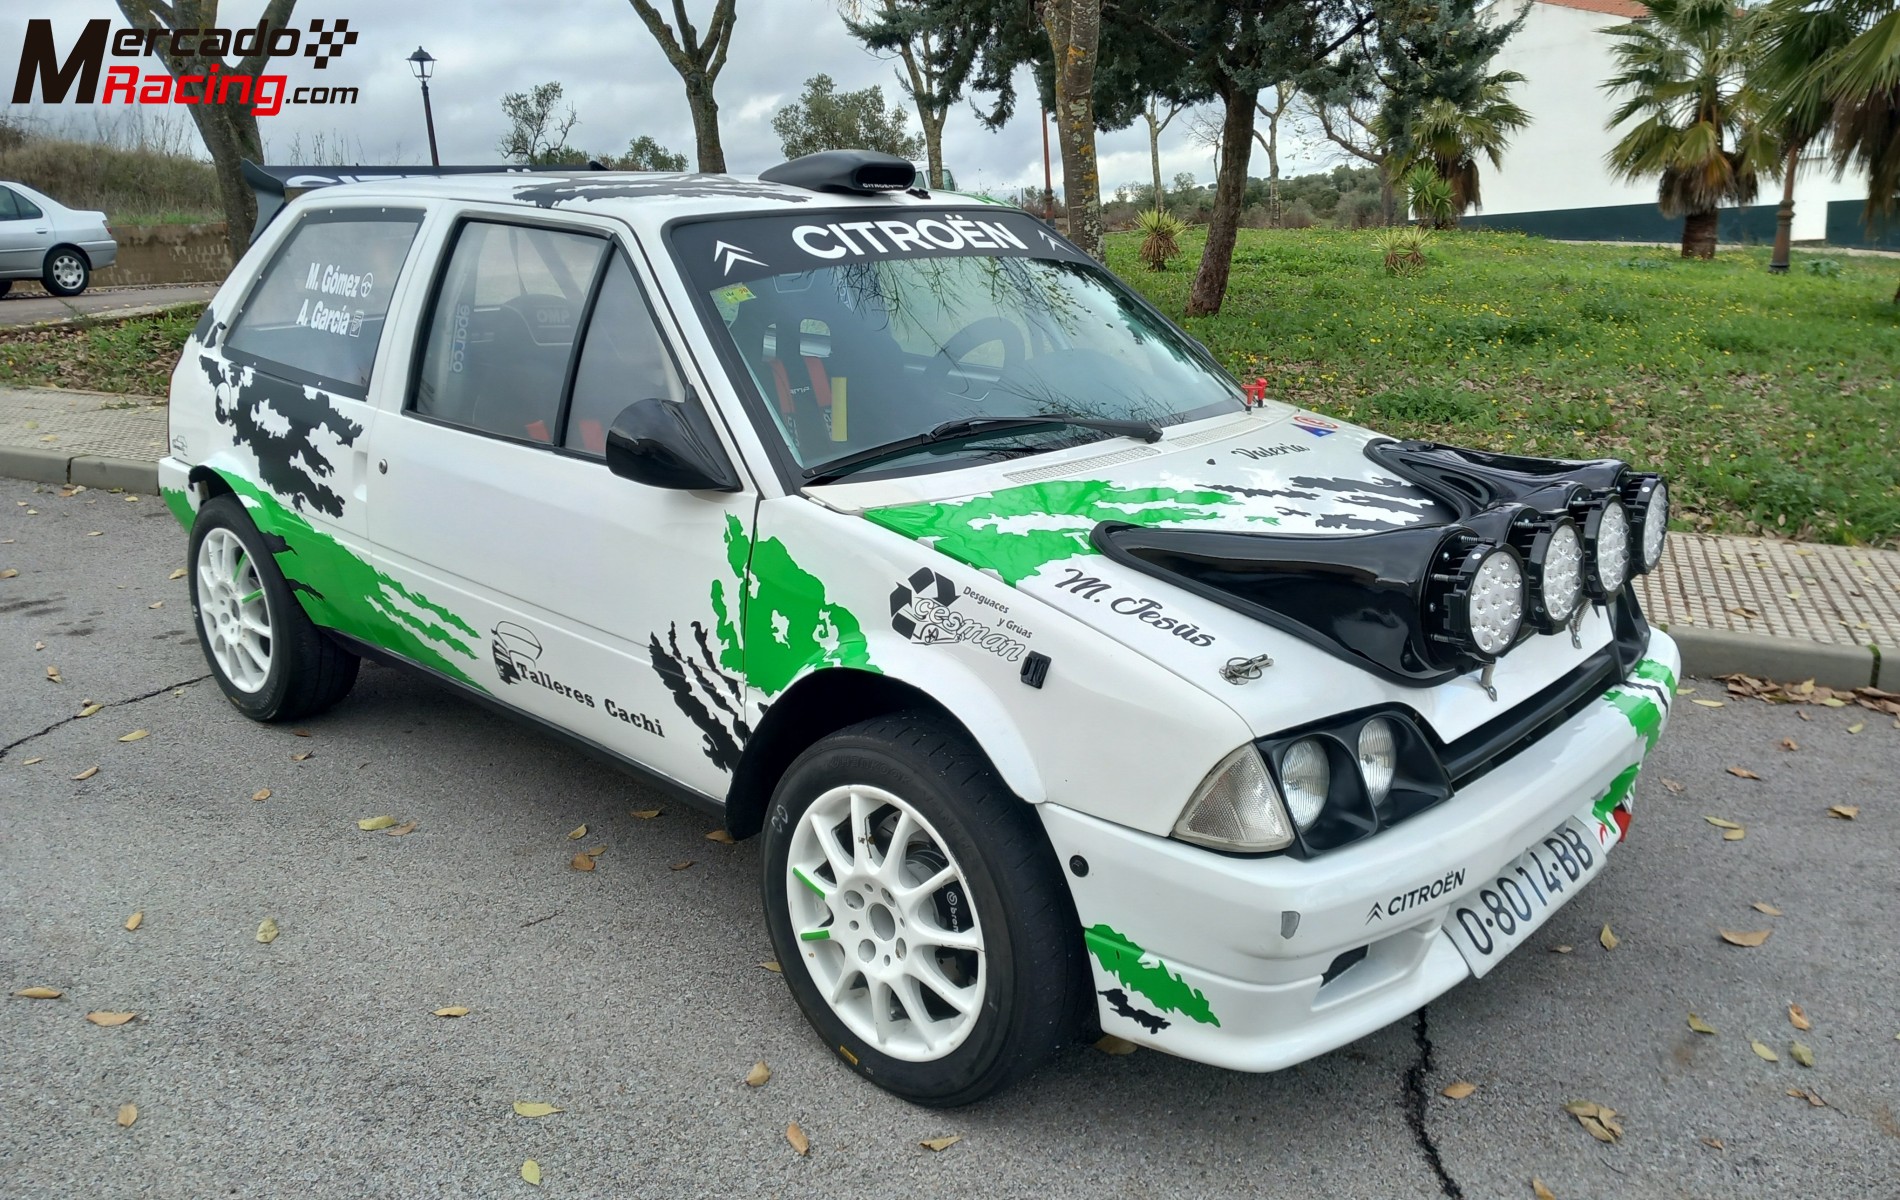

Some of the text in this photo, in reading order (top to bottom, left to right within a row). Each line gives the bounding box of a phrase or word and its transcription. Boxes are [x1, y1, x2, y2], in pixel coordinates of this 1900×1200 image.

[792, 214, 1029, 259] CITROËN
[305, 262, 360, 297] M. Gómez
[296, 299, 351, 335] A. García
[963, 586, 1010, 614] Desguaces
[1054, 568, 1113, 603] M.
[997, 617, 1006, 627] y
[517, 662, 665, 738] Talleres Cachi
[1387, 868, 1466, 916] CITROËN
